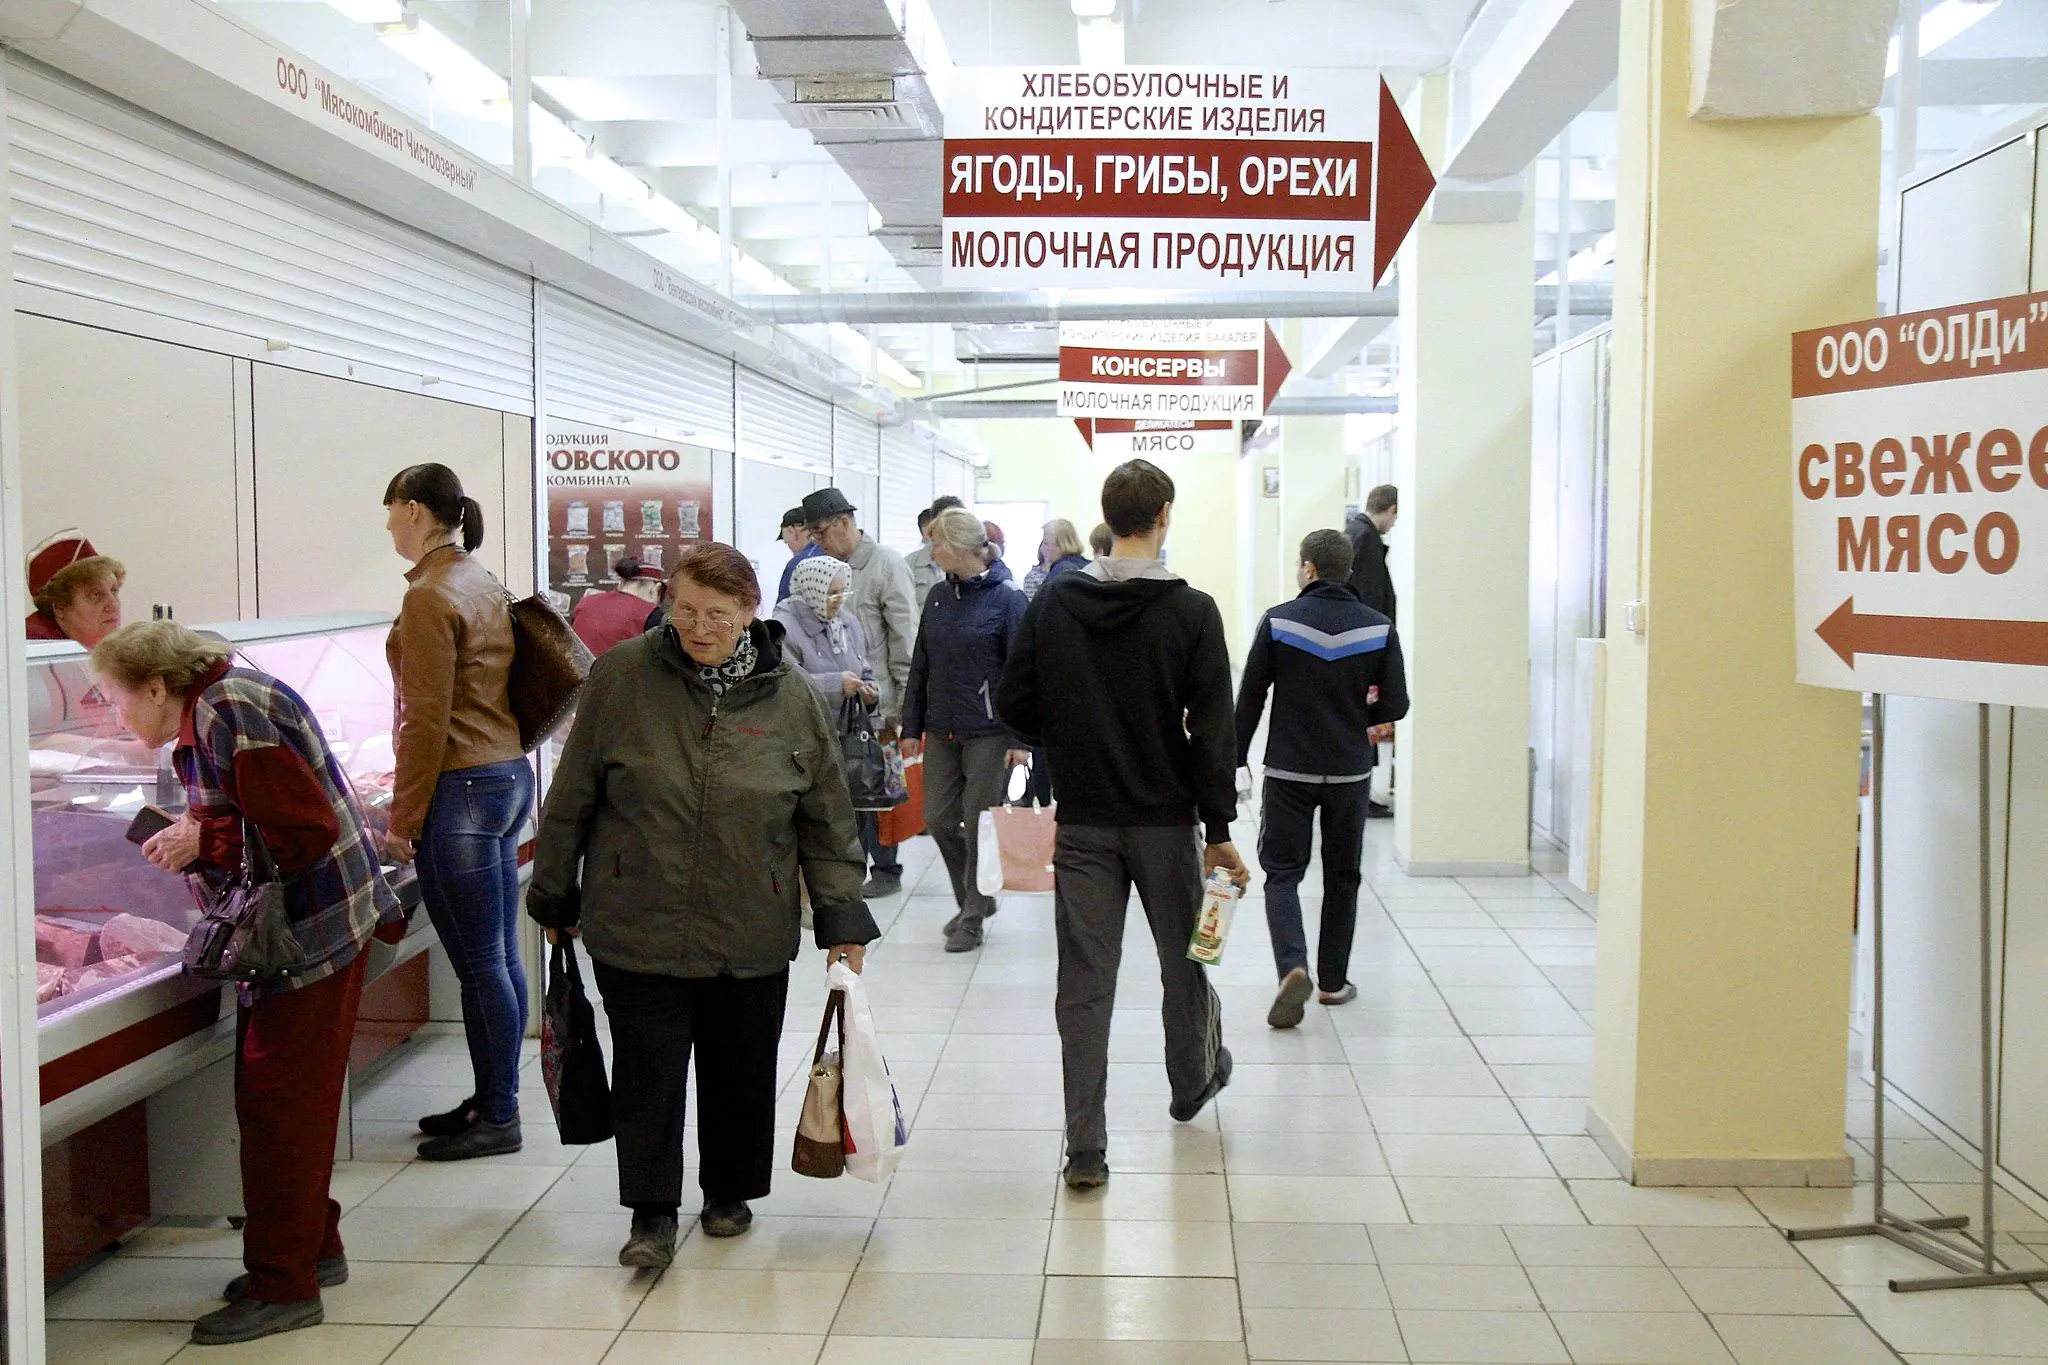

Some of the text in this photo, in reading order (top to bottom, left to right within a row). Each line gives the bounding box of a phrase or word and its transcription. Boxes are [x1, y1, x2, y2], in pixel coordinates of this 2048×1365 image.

[276, 57, 307, 99] ООО
[1021, 73, 1289, 99] ХЛЕБОБУЛОЧНЫЕ И
[984, 106, 1326, 136] КОНДИТЕРСКИЕ ИЗДЕЛИЯ
[949, 154, 1358, 202] ЯГОДЫ, ГРИБЫ, ОРЕХИ
[951, 230, 1355, 278] МОЛОЧНАЯ ПРОДУКЦИЯ
[1091, 355, 1226, 378] КОНСЕРВЫ
[1815, 326, 1889, 379] ООО
[1062, 390, 1254, 412] МОЛОЧНАЯ ПРОДУКЦИЯ
[1132, 434, 1194, 451] МЯСО
[547, 449, 681, 471] ОВСКОГО
